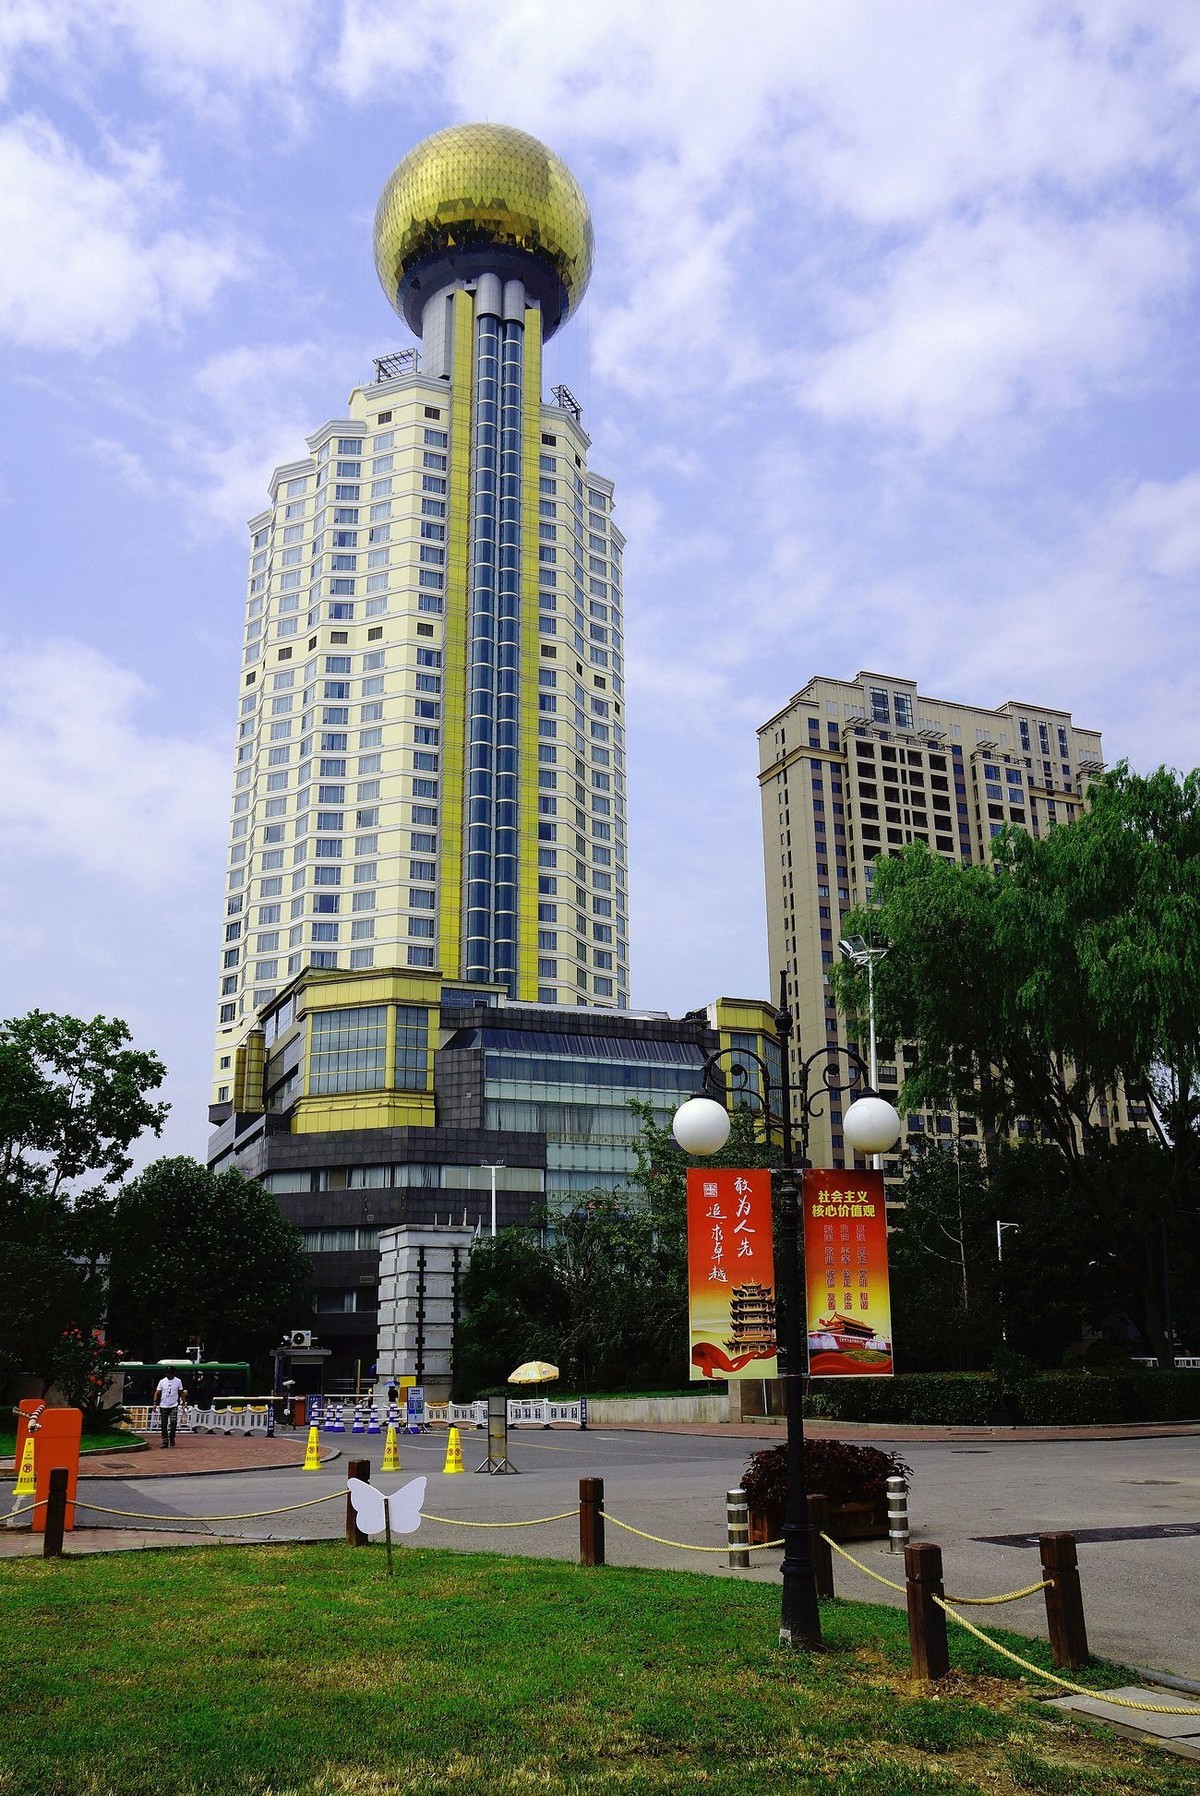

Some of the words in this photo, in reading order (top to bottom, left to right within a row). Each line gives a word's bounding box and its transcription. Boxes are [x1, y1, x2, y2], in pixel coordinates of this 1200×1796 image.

[818, 1190, 869, 1204] 社会主义
[733, 1176, 756, 1258] 敢为人先
[811, 1204, 876, 1218] 核心价值观
[705, 1203, 728, 1283] 追求卓越
[860, 1292, 869, 1310] 和谐
